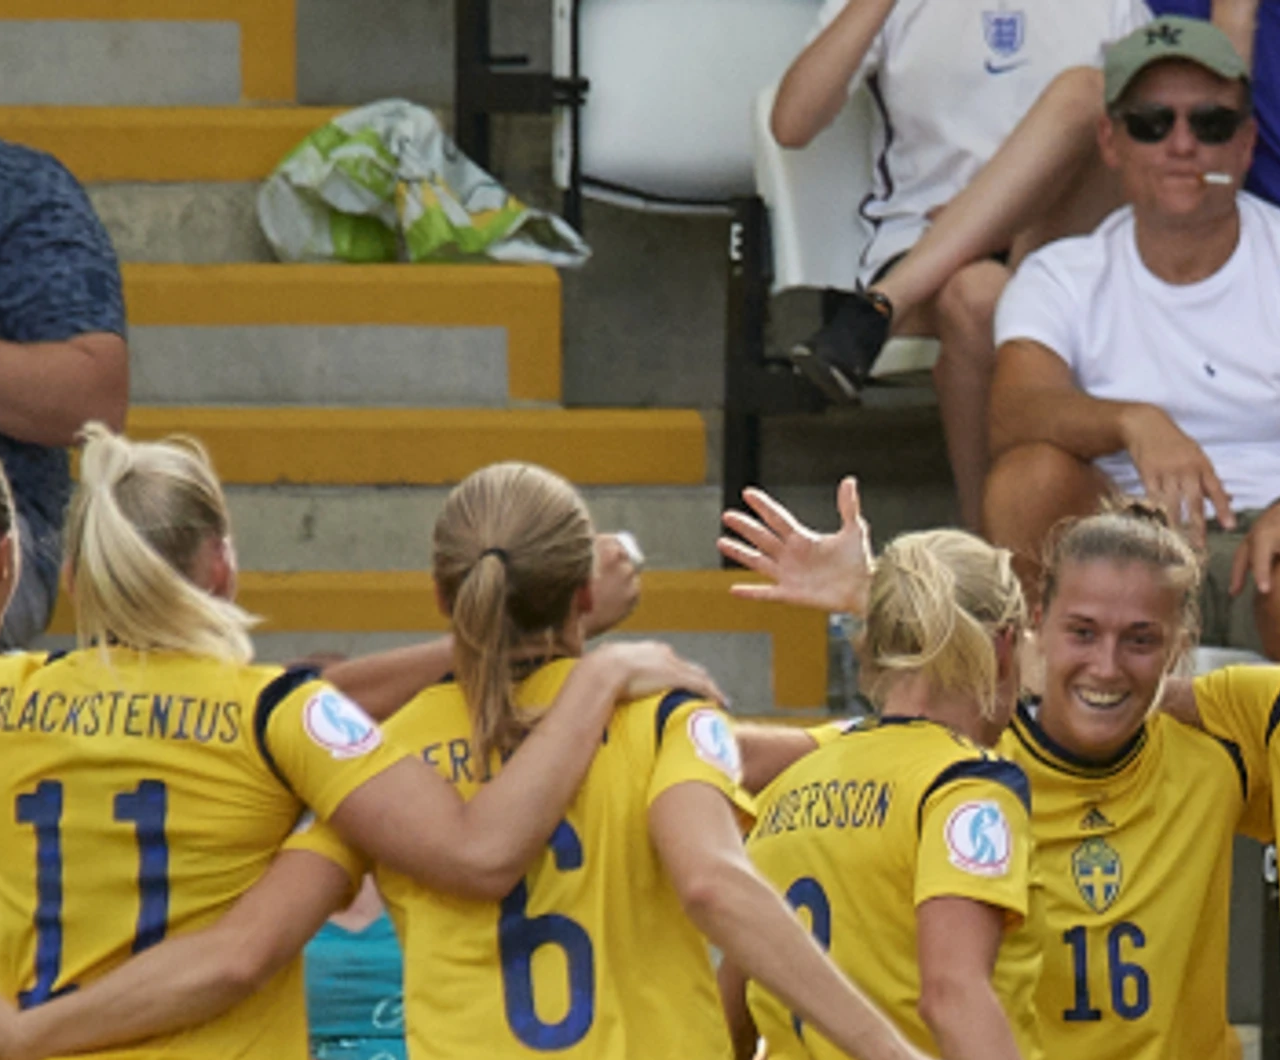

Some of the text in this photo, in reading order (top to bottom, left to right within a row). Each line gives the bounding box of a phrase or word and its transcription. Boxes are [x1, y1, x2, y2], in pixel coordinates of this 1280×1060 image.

[14, 778, 170, 1011] 11
[497, 818, 596, 1051] 6
[1062, 920, 1151, 1022] 16
